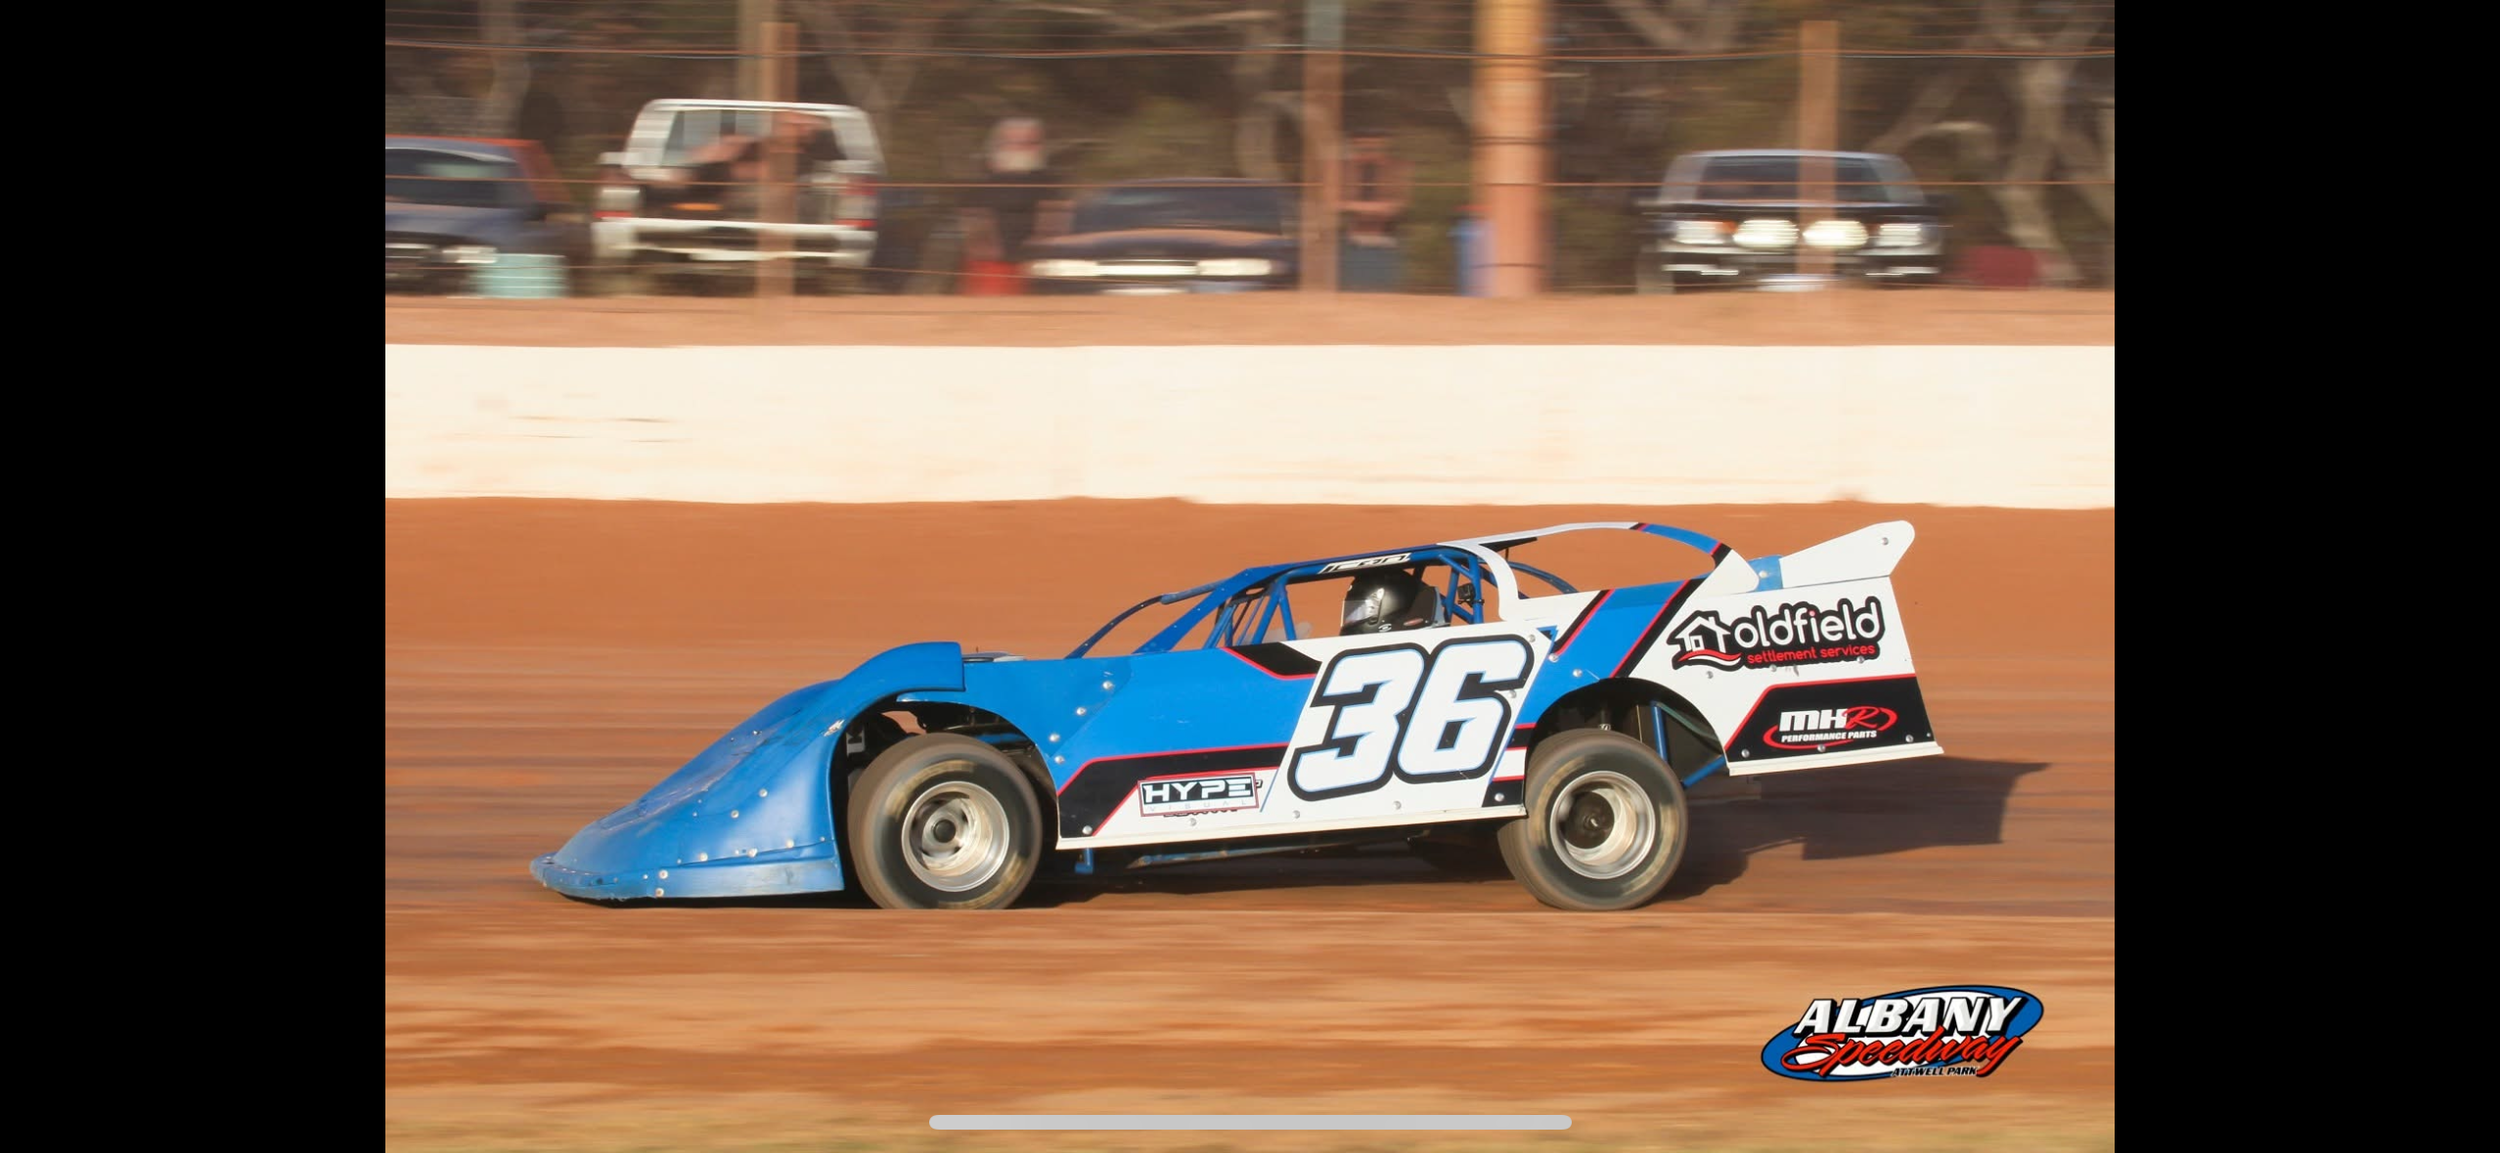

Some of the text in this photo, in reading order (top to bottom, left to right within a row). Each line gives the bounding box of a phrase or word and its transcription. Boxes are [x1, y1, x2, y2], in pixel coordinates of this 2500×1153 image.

[1734, 601, 1880, 648] oldfield
[1747, 645, 1876, 664] settlement services
[1288, 634, 1534, 801] 36
[1779, 706, 1880, 731] MHR
[1781, 730, 1878, 743] PERFORMANCE PARTS
[1143, 778, 1251, 803] HYPE
